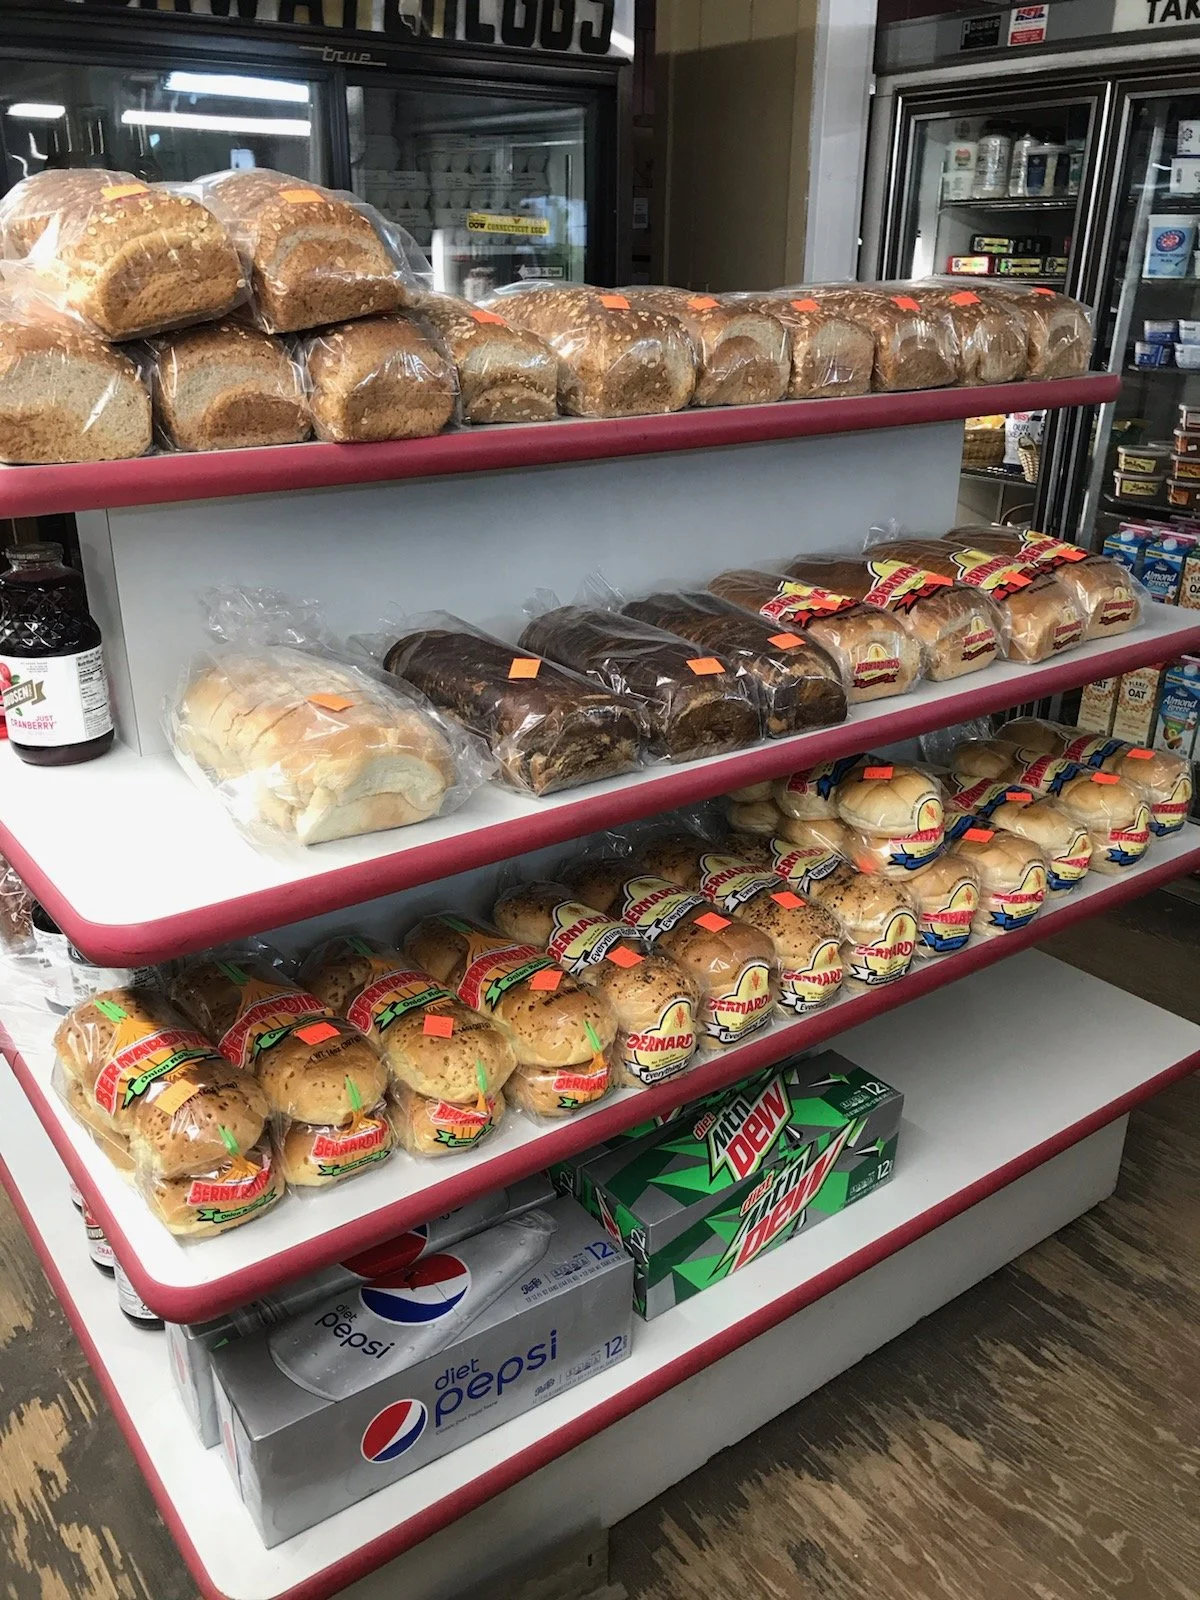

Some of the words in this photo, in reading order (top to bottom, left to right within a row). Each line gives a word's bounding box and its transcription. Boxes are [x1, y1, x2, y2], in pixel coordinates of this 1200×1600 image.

[1128, 688, 1147, 699] OAT
[1163, 695, 1198, 709] Almond
[11, 718, 54, 730] CRANBERRY
[402, 995, 426, 1008] Onion
[141, 1063, 170, 1085] Onion
[860, 1081, 886, 1096] 12
[694, 1111, 717, 1139] diet
[877, 1159, 890, 1180] 12
[584, 1241, 615, 1260] 12
[336, 1303, 357, 1323] diet
[314, 1312, 395, 1359] pepsi
[604, 1335, 622, 1359] 12
[434, 1358, 480, 1390] diet
[435, 1329, 557, 1428] pepsi
